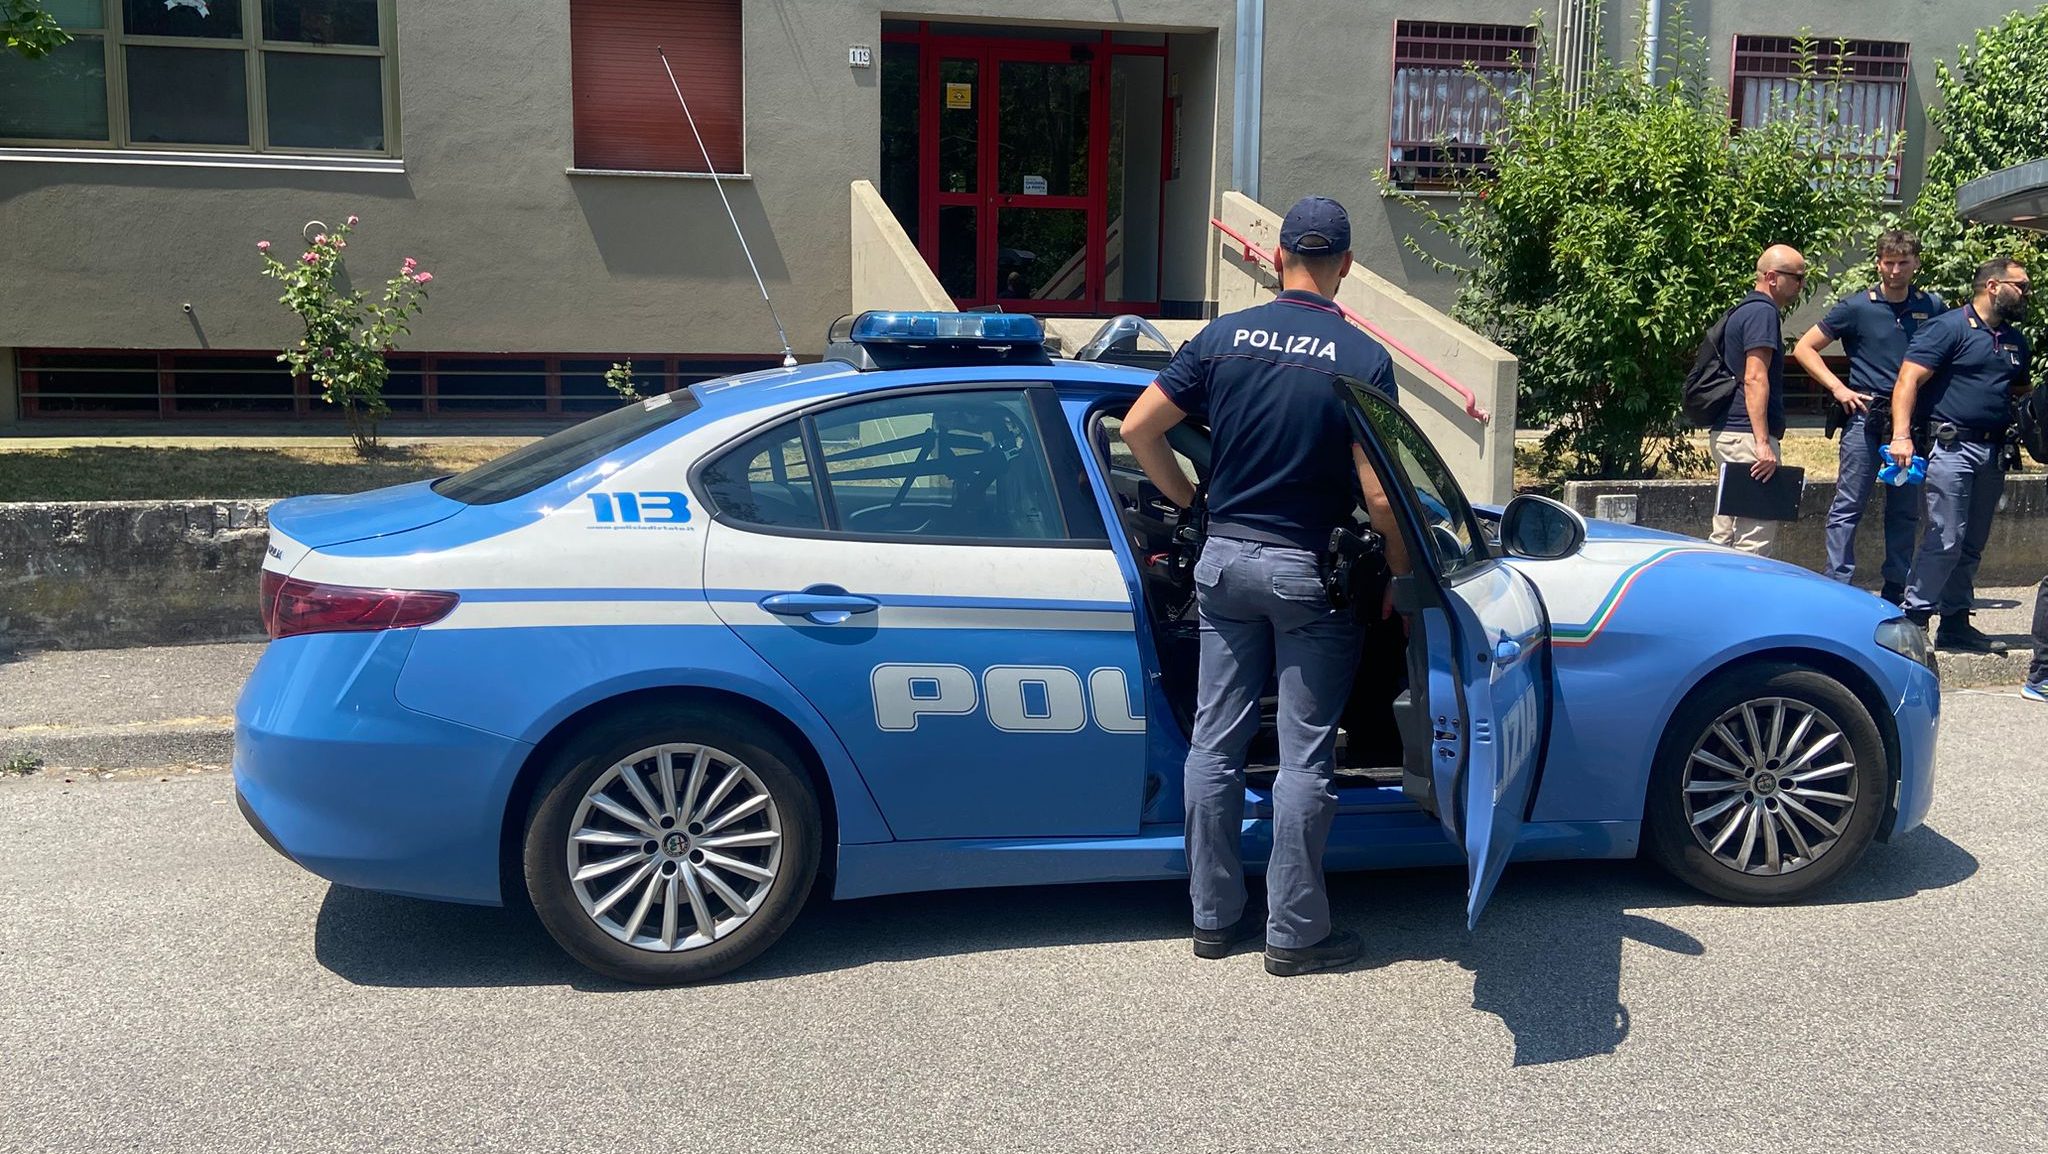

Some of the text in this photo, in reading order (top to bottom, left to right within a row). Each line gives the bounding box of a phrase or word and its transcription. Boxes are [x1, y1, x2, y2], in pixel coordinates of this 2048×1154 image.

[1233, 329, 1336, 361] POLIZIA
[587, 491, 692, 523] 113
[870, 662, 1147, 734] POL
